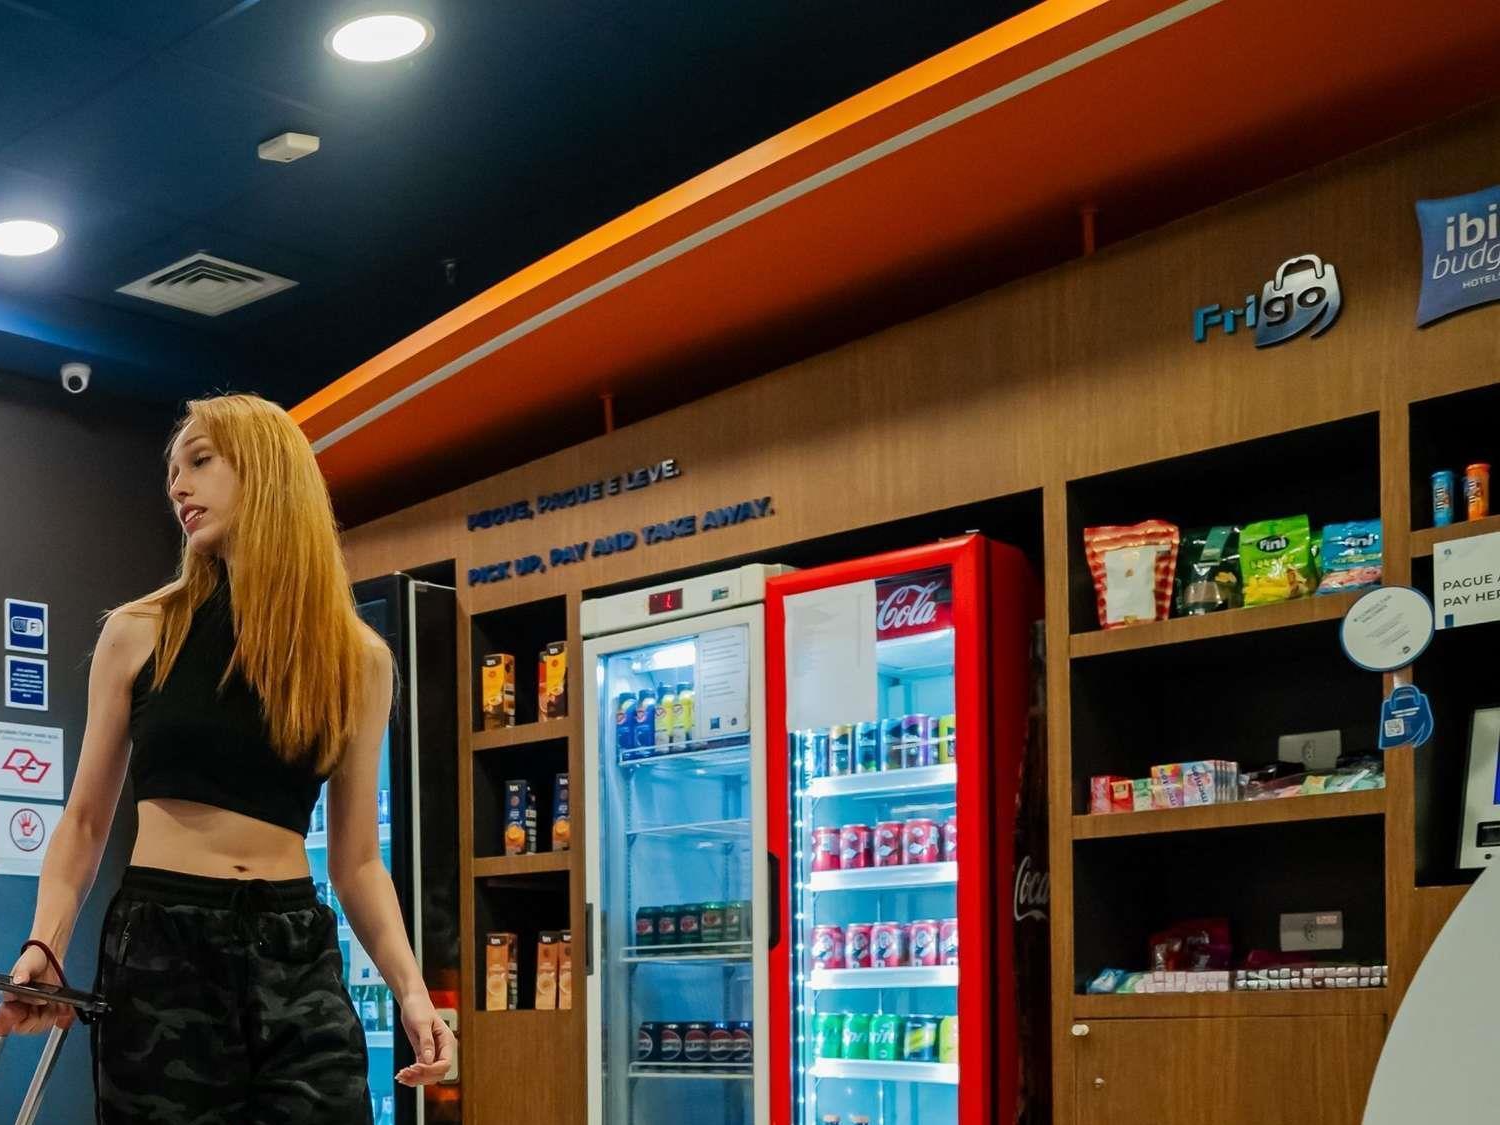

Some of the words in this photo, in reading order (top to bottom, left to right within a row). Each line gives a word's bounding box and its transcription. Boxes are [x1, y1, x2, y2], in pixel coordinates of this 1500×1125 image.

[1446, 204, 1498, 252] ibi
[1432, 241, 1500, 280] budg
[1462, 272, 1500, 288] HOTEL
[625, 458, 682, 490] LEVE.
[550, 542, 588, 567] PAY
[590, 530, 637, 558] AND
[642, 515, 697, 546] TAKE
[702, 496, 776, 531] AWAY.
[1442, 573, 1493, 591] PAGUE
[1443, 594, 1471, 608] PAY
